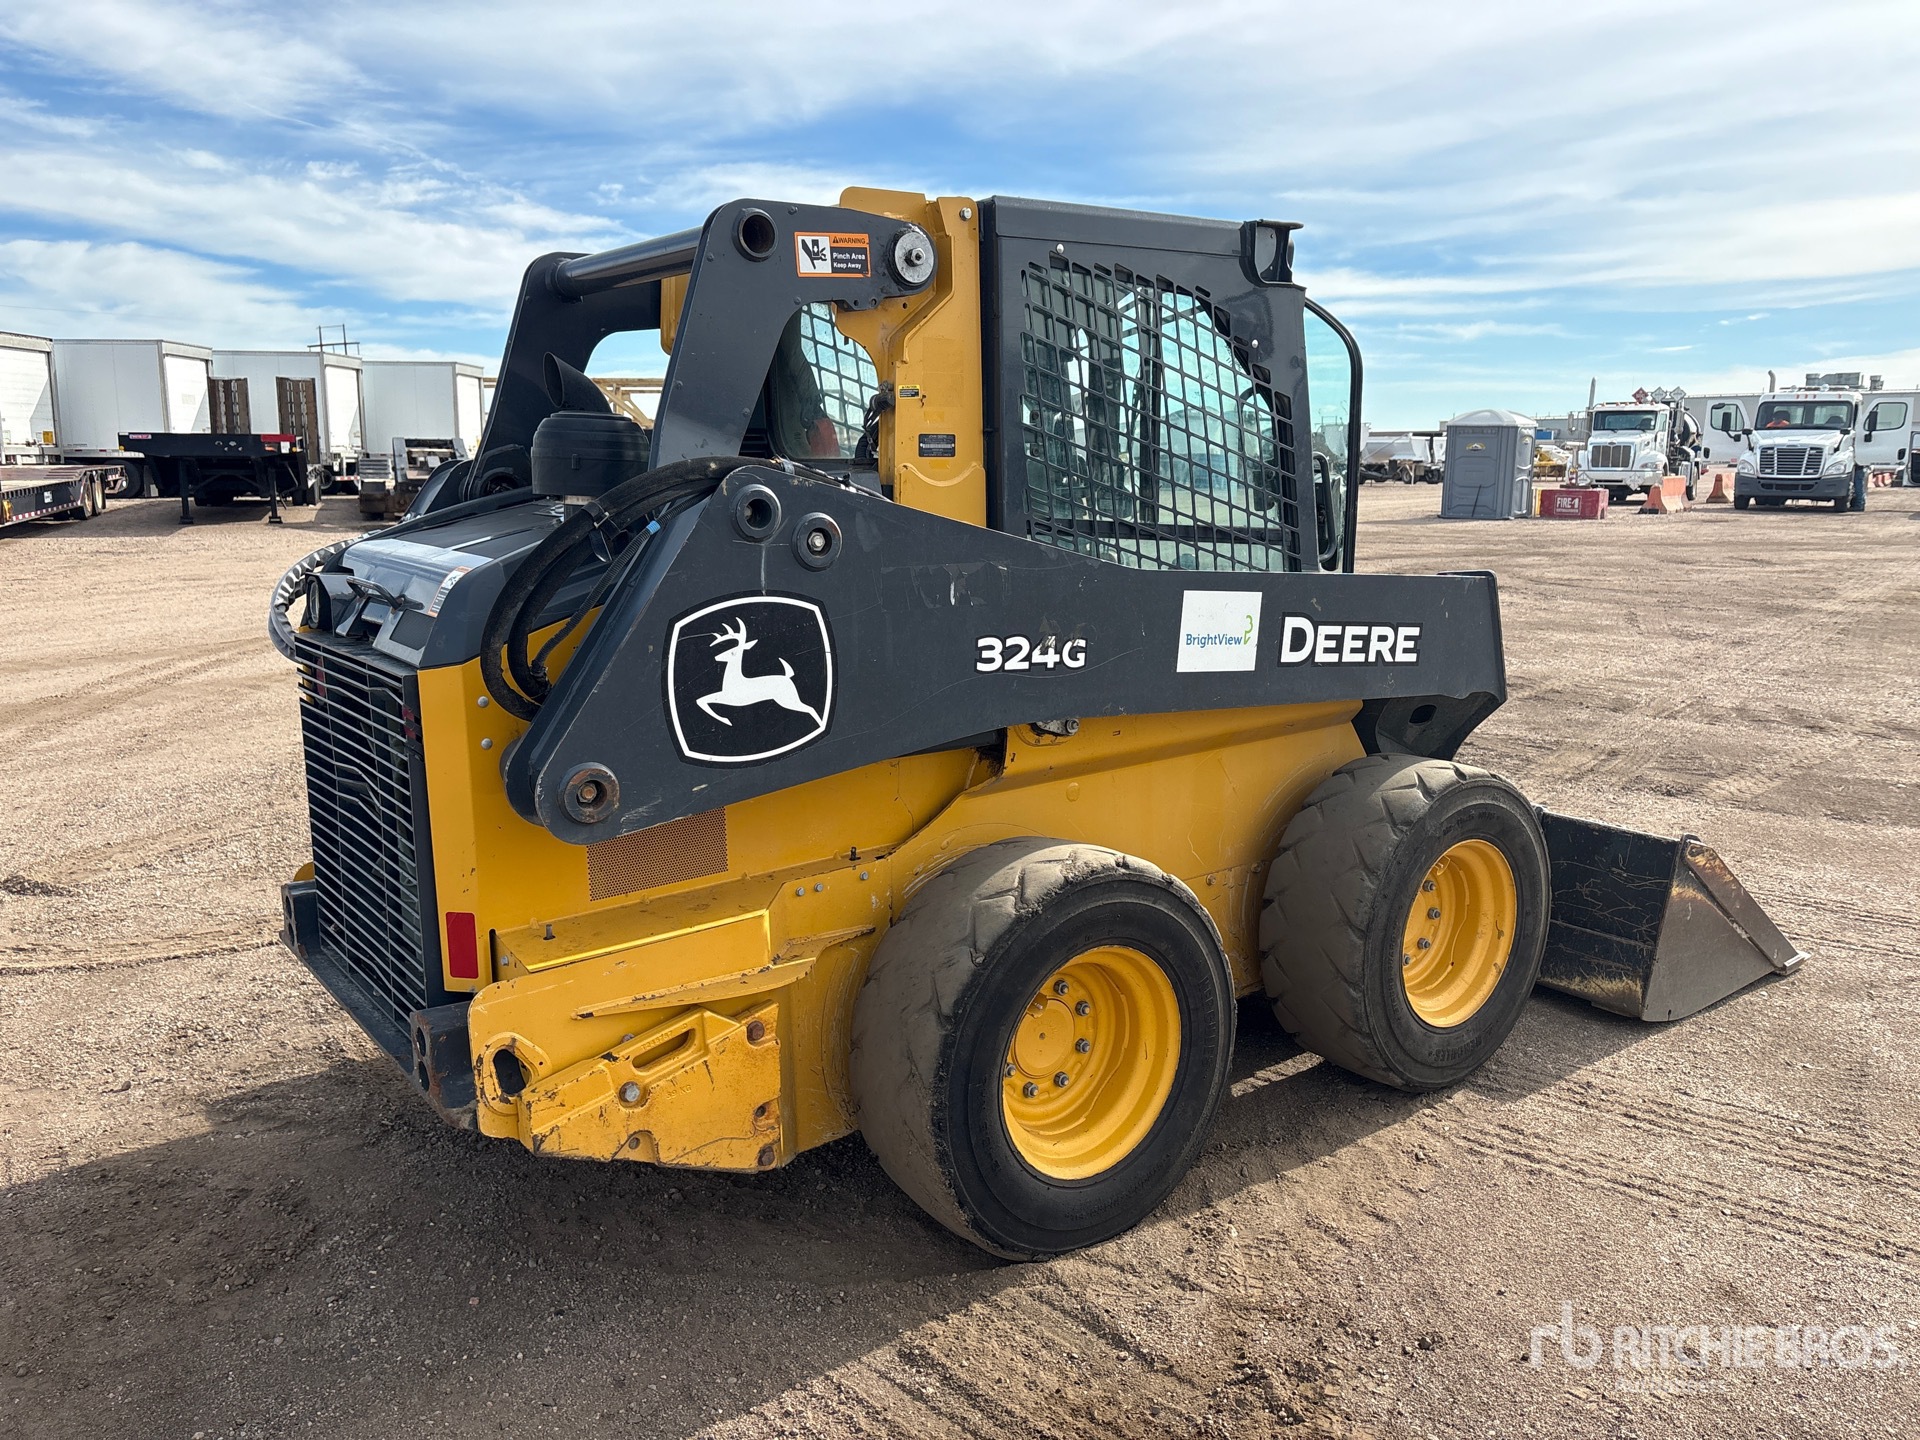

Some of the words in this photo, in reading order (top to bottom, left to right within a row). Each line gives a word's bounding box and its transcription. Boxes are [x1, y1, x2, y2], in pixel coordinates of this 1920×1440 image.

[832, 252, 850, 260] Pinch
[851, 252, 866, 260] Area
[833, 261, 847, 269] Keep
[847, 262, 862, 270] Away
[1185, 633, 1243, 648] BrightView
[1280, 616, 1421, 663] DEERE
[976, 635, 1086, 672] 324G
